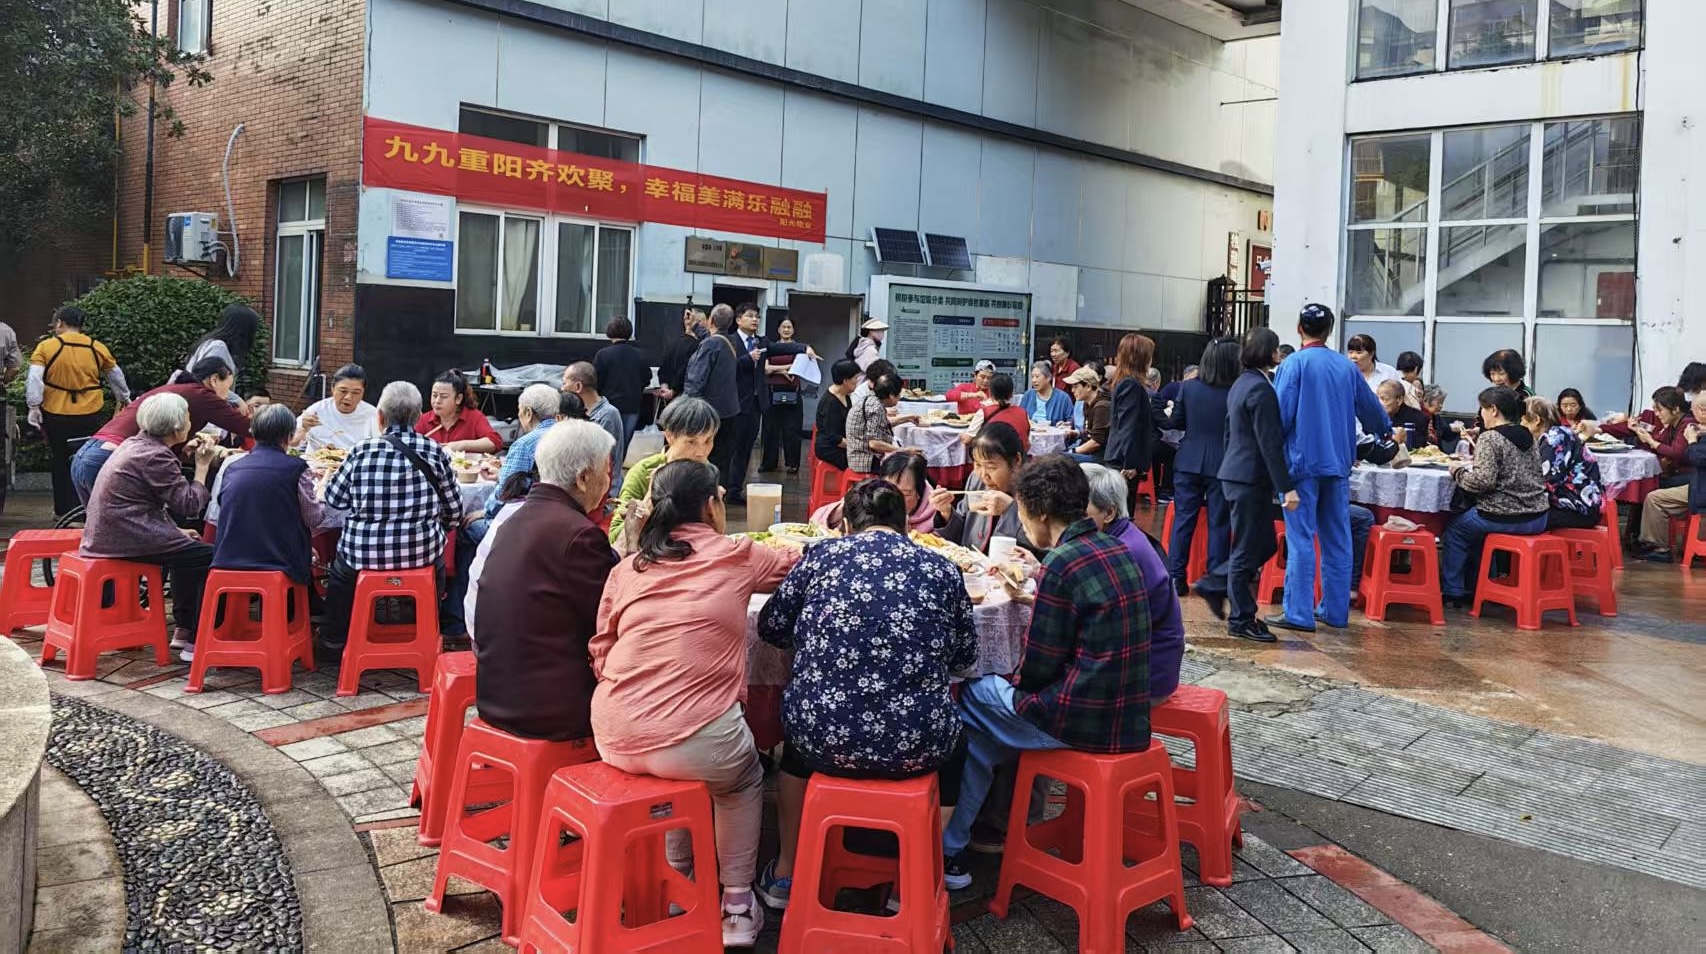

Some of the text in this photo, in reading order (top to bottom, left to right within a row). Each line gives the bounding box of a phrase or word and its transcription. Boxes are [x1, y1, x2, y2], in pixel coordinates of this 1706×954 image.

[384, 135, 813, 220] 九九重阳齐欢聚，幸福美满乐融融
